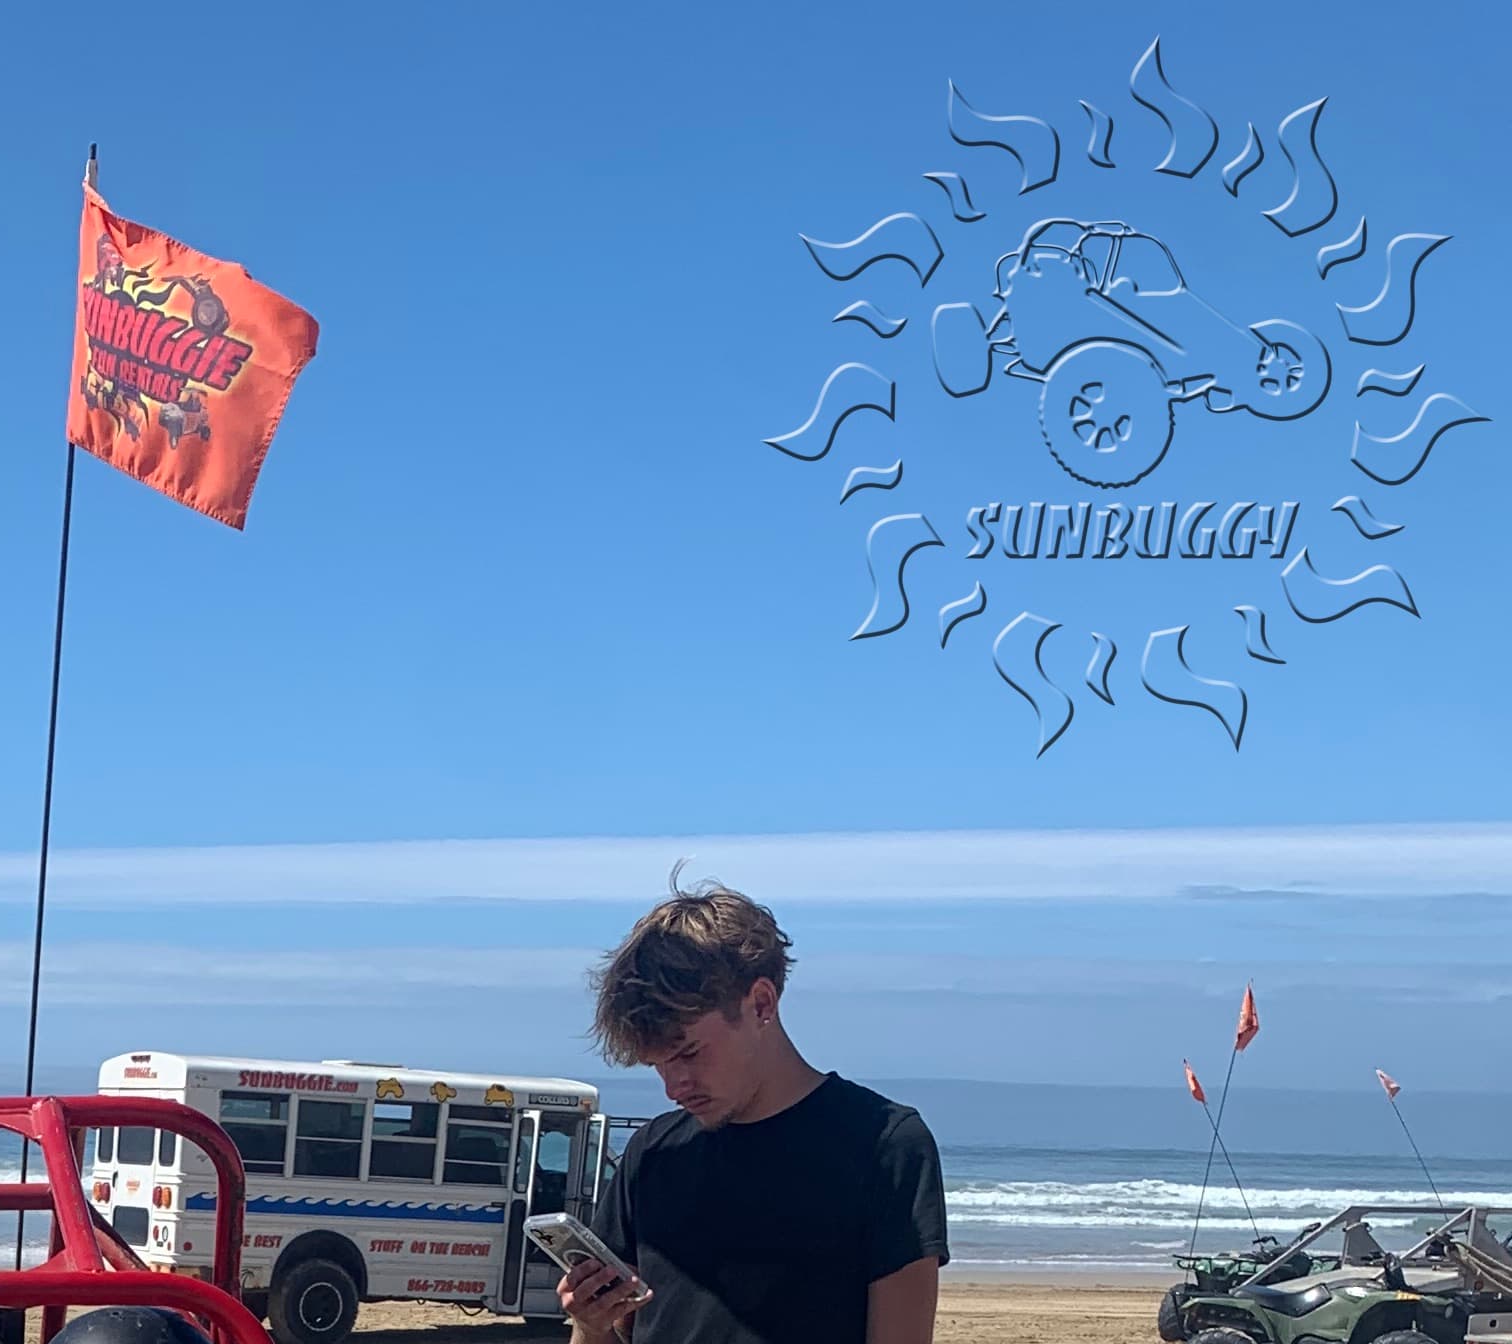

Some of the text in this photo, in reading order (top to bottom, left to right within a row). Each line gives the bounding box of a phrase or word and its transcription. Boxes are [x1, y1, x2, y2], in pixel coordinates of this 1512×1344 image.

[538, 1095, 570, 1105] COLLINS
[254, 1234, 283, 1248] BEST
[369, 1239, 404, 1253] STUFF
[410, 1240, 427, 1254] ON
[429, 1241, 450, 1255] THE
